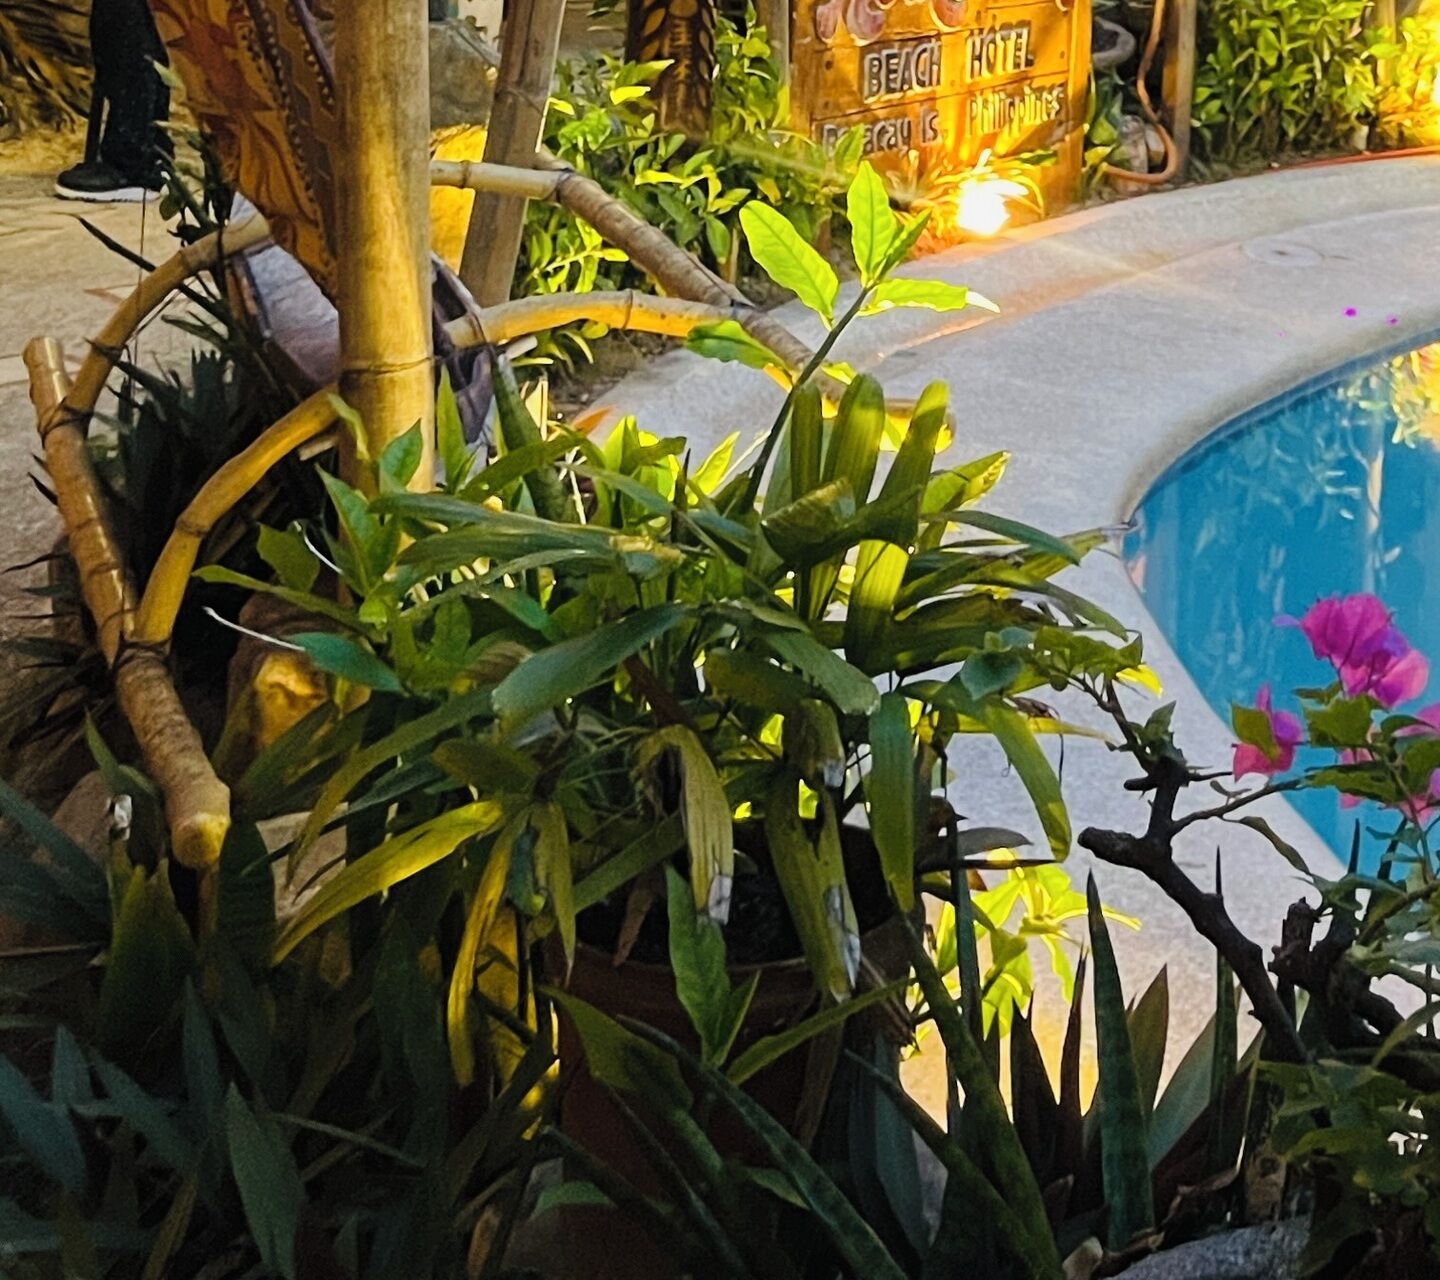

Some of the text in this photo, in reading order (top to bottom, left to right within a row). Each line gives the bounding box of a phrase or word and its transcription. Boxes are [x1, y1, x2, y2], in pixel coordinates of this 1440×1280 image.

[863, 26, 1034, 105] BEACH HOTEL
[821, 117, 912, 156] Bacay
